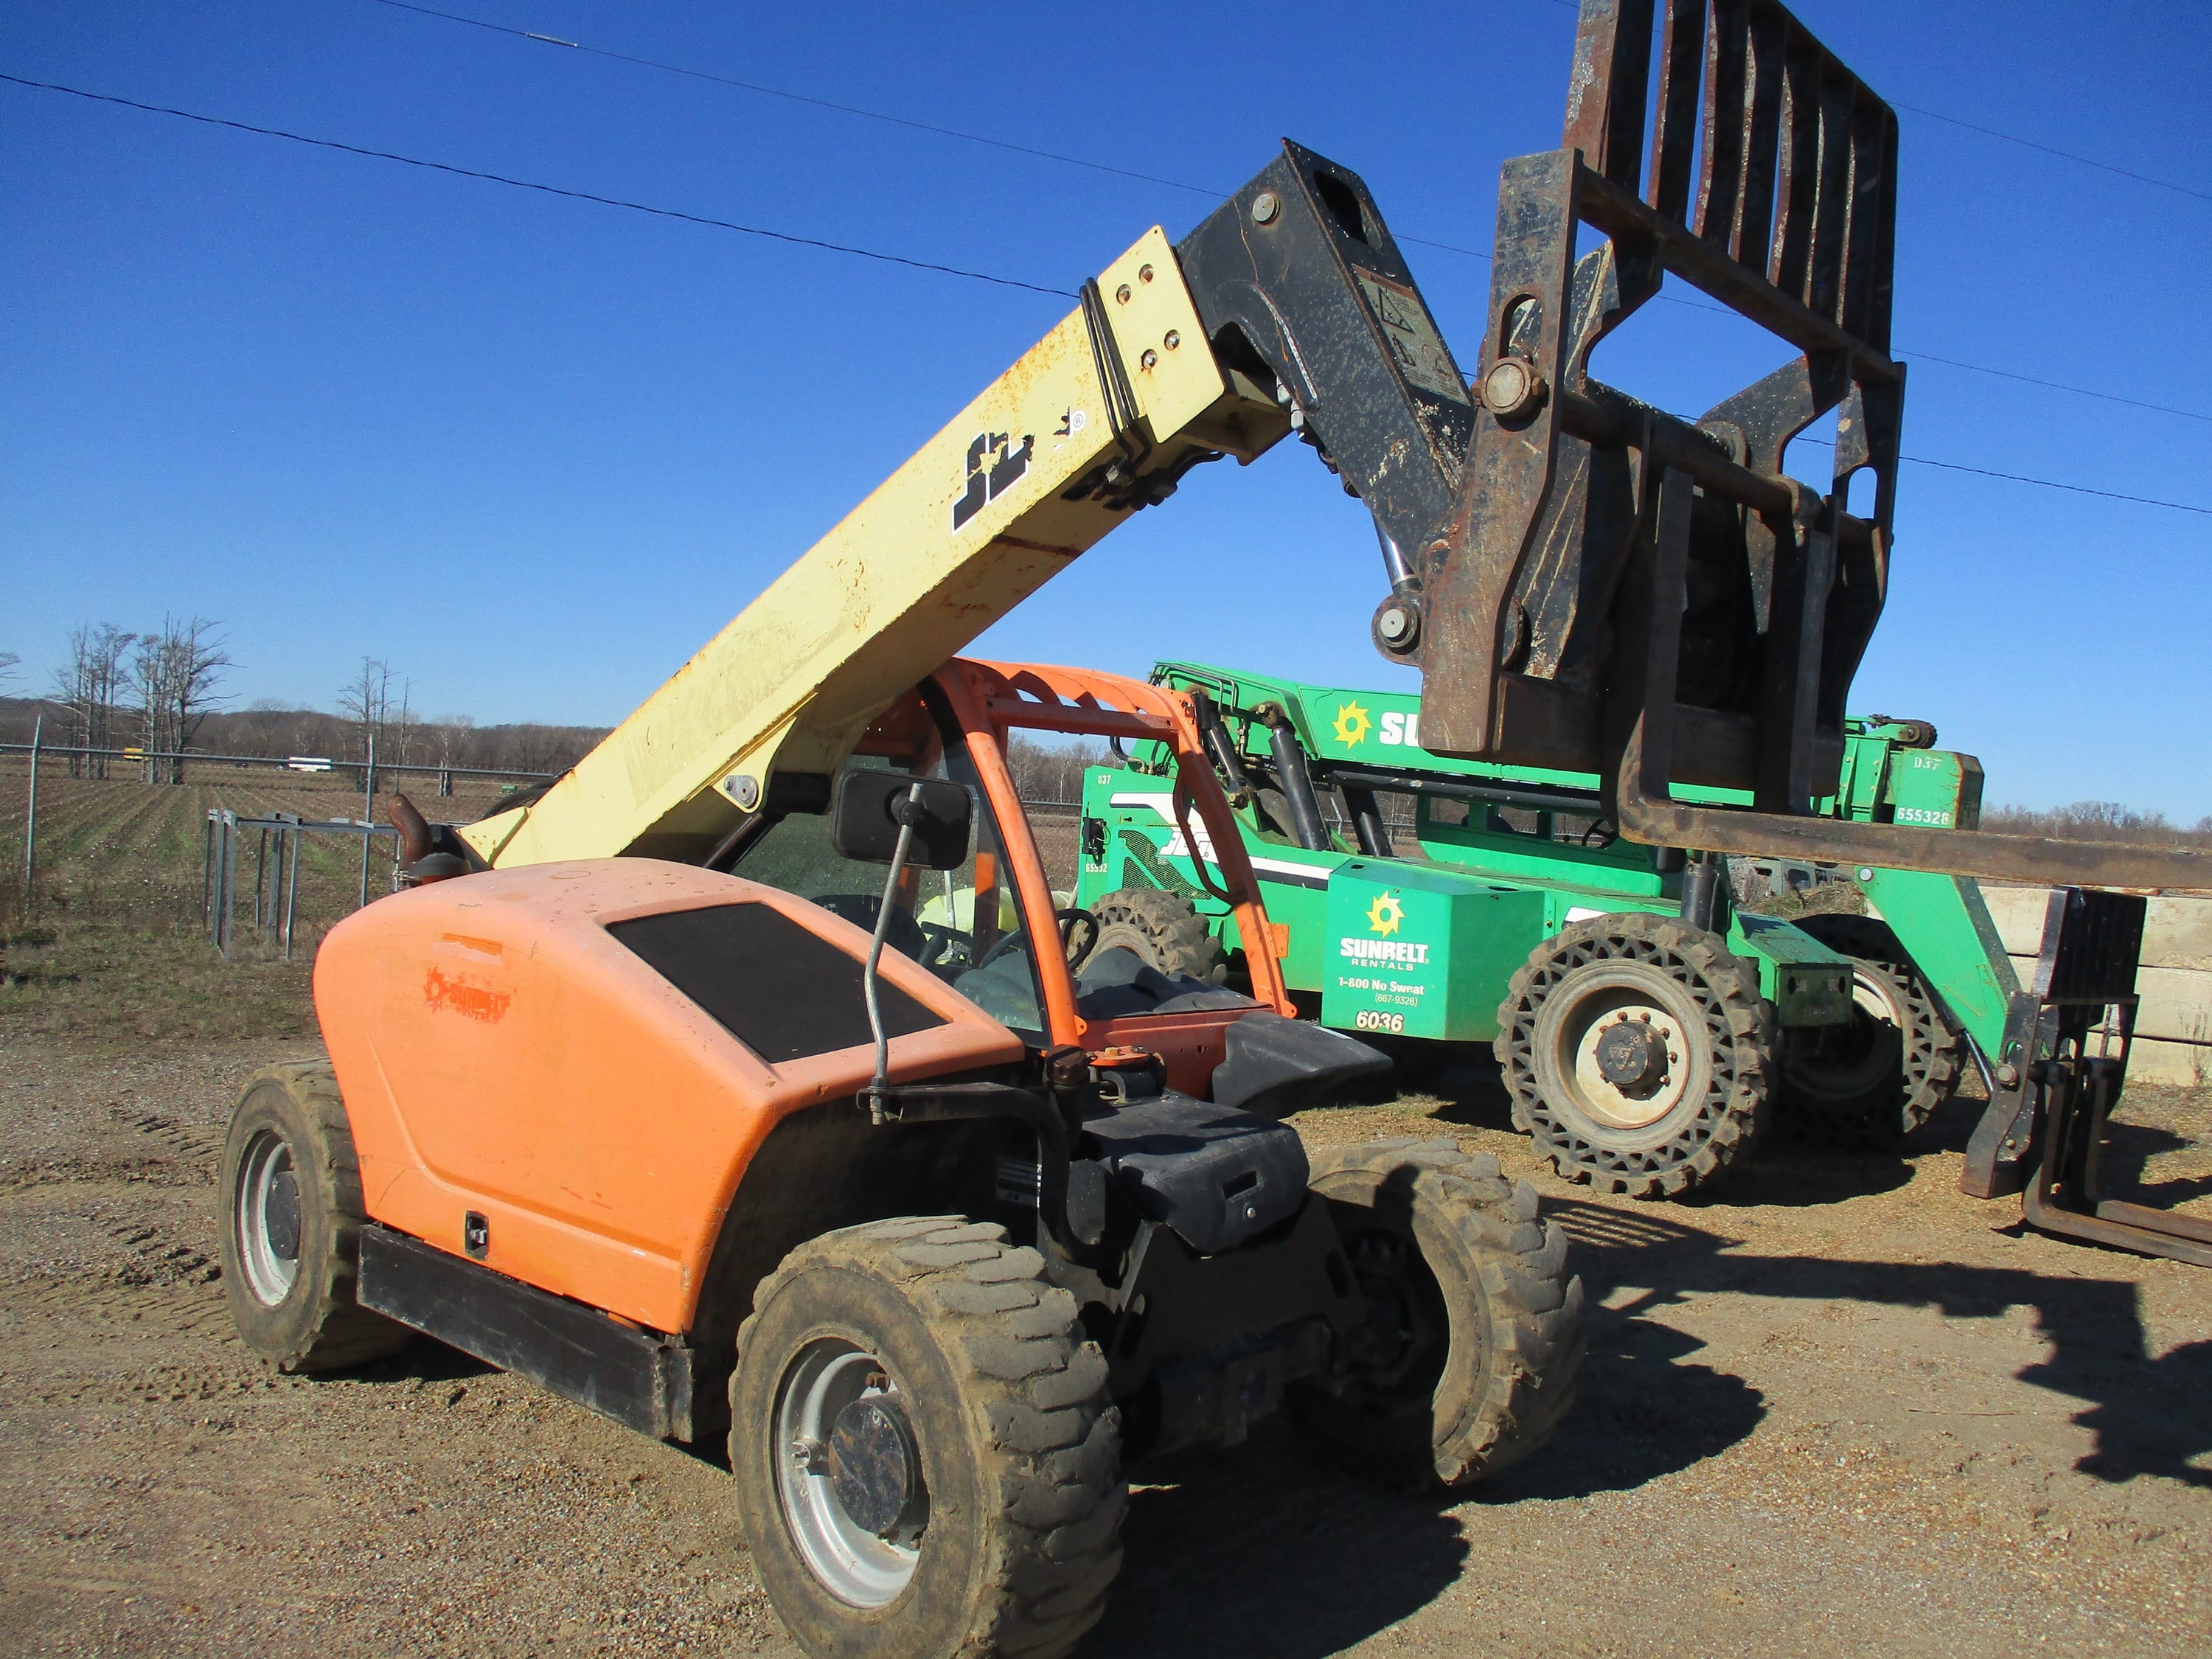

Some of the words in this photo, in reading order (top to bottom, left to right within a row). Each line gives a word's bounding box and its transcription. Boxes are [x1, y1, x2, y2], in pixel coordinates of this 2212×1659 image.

[1379, 712, 1420, 748] SU
[1097, 775, 1111, 785] 037
[1340, 937, 1429, 964] SUNBELT
[1351, 958, 1414, 972] RENTALS
[1338, 976, 1369, 990] 1-800
[1371, 979, 1388, 991] No
[1389, 981, 1425, 995] Sweat
[1375, 992, 1419, 1007] (667-9328)
[1355, 1009, 1405, 1033] 6036
